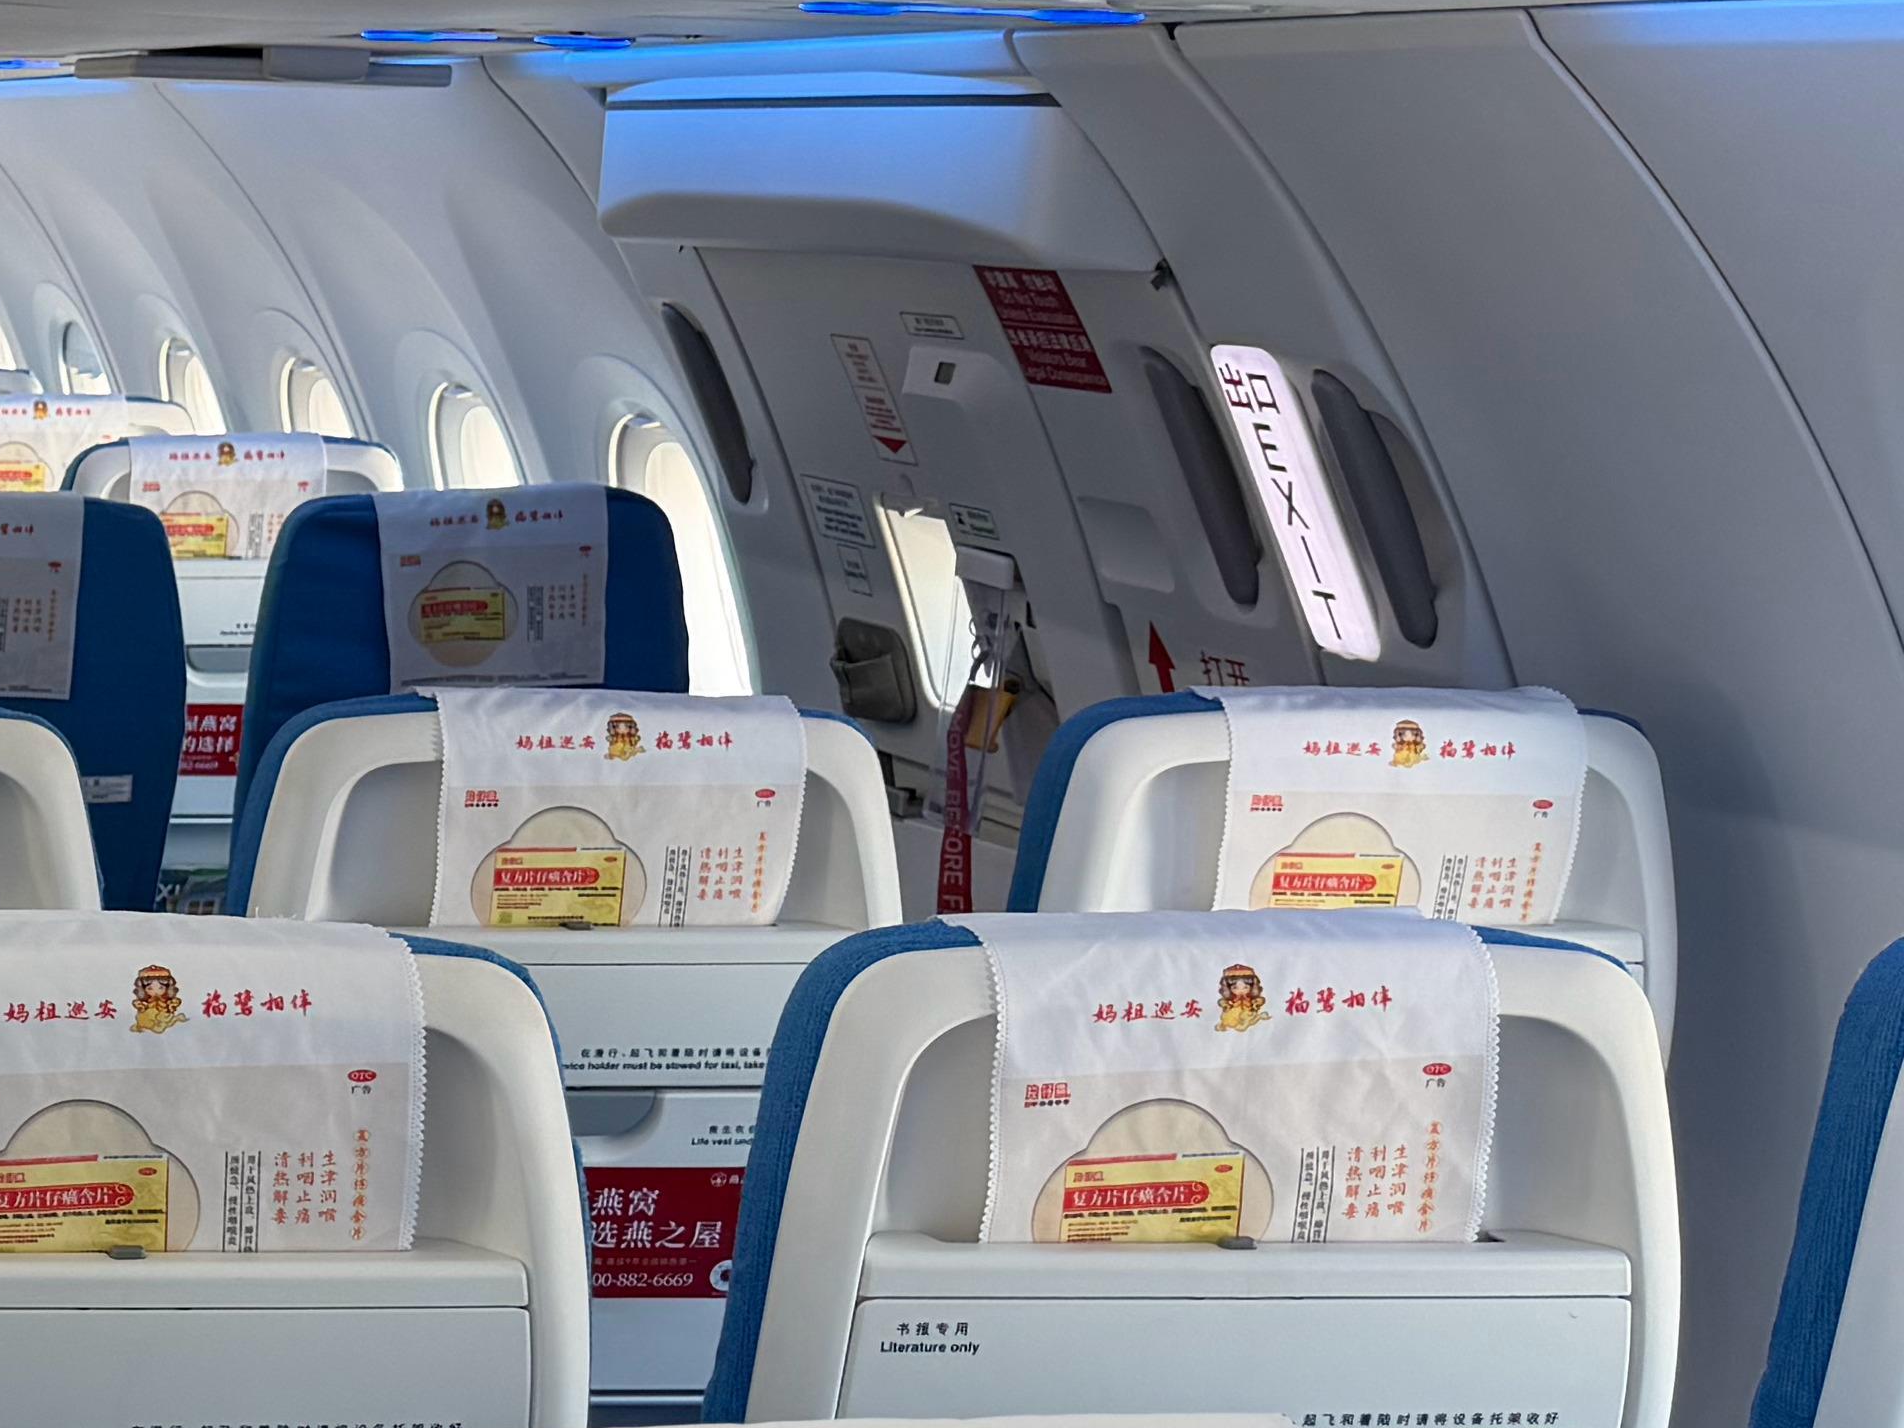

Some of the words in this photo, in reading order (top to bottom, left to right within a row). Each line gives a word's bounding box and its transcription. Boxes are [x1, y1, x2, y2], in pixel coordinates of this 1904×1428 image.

[1218, 362, 1280, 416] 出口
[1252, 423, 1342, 640] EXIT
[3, 998, 120, 1024] 妈祖巡安
[201, 988, 314, 1019] 福鹭相伴
[1092, 998, 1203, 1025] 妈祖巡安
[1284, 986, 1395, 1017] 福鹭相伴
[591, 1188, 660, 1216] 燕窝
[592, 1273, 693, 1287] 00-882-6669
[895, 1320, 970, 1337] 书报专用
[879, 1340, 945, 1355] Literature
[948, 1340, 981, 1357] only
